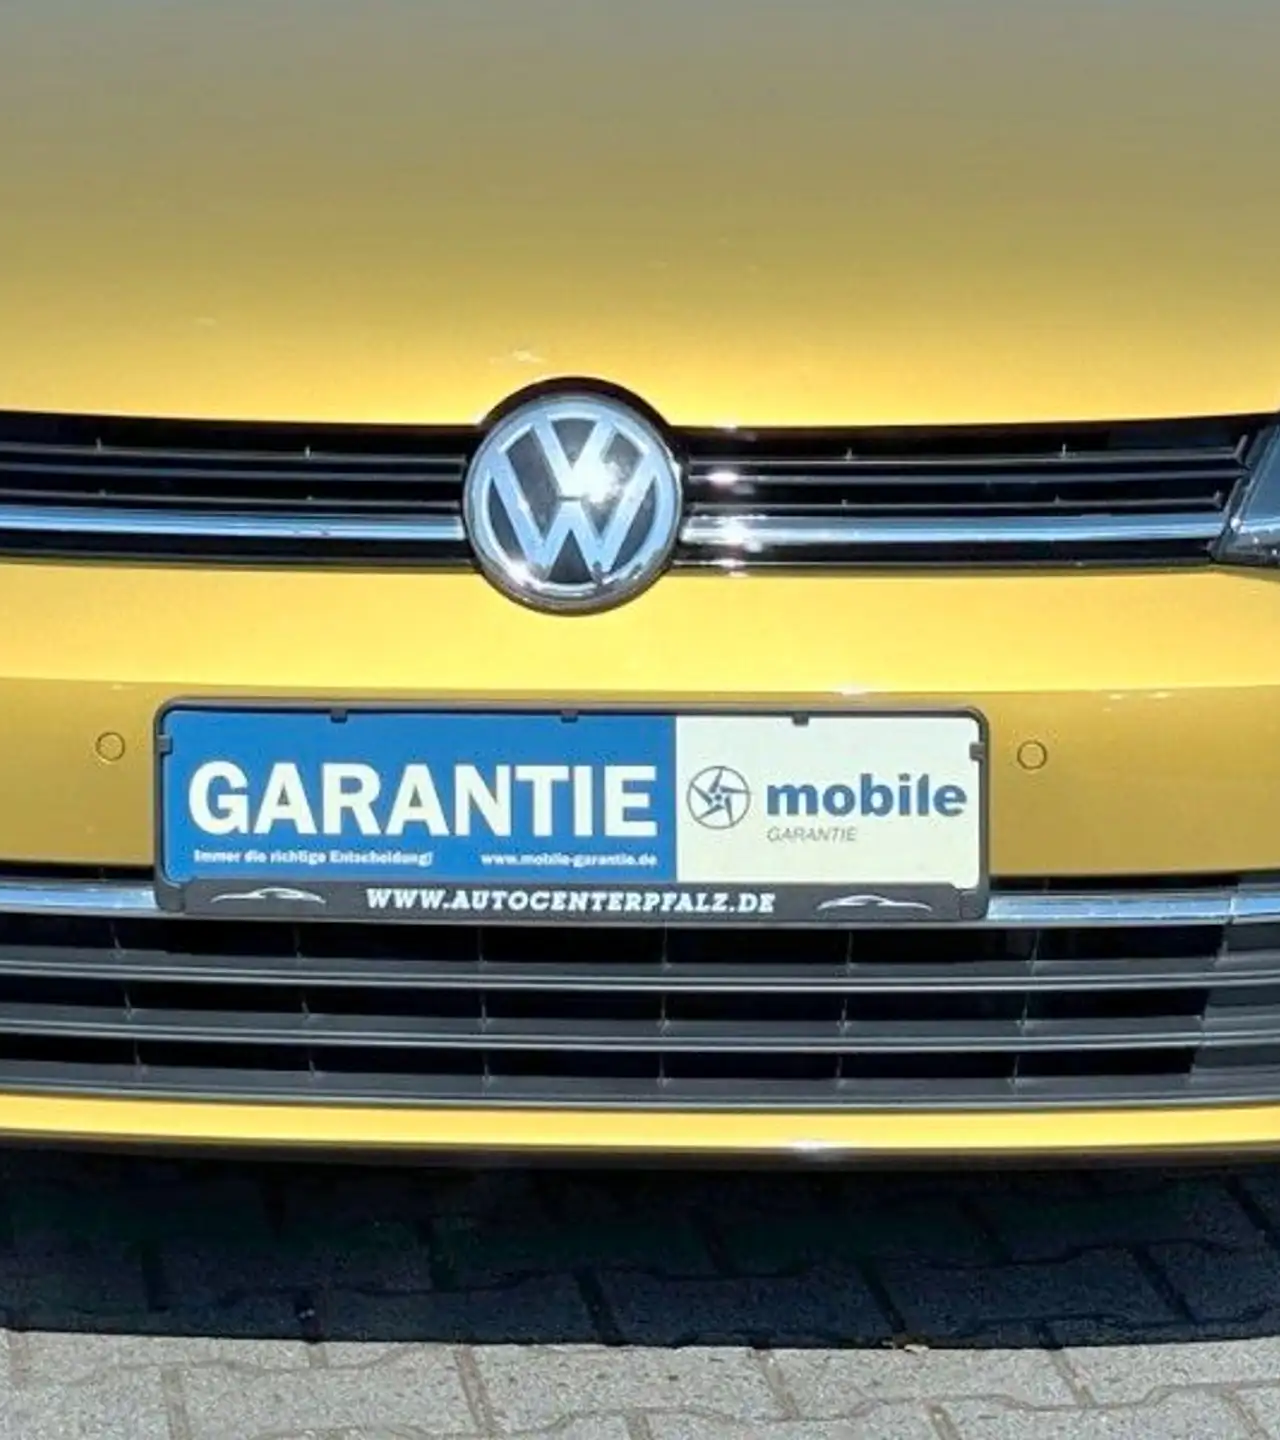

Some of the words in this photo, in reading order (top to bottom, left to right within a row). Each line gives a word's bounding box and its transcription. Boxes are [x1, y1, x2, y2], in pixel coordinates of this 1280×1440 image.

[478, 402, 665, 584] VW
[188, 760, 658, 838] GARANTIE
[766, 772, 968, 818] mobile
[766, 825, 856, 843] GARANTIE
[194, 849, 242, 863] Immer
[243, 849, 268, 863] die
[269, 850, 327, 866] richtige
[481, 852, 658, 868] www.mobile-garantie.de
[366, 887, 777, 913] WWW.AUTOCENTERPFALZ.DE
